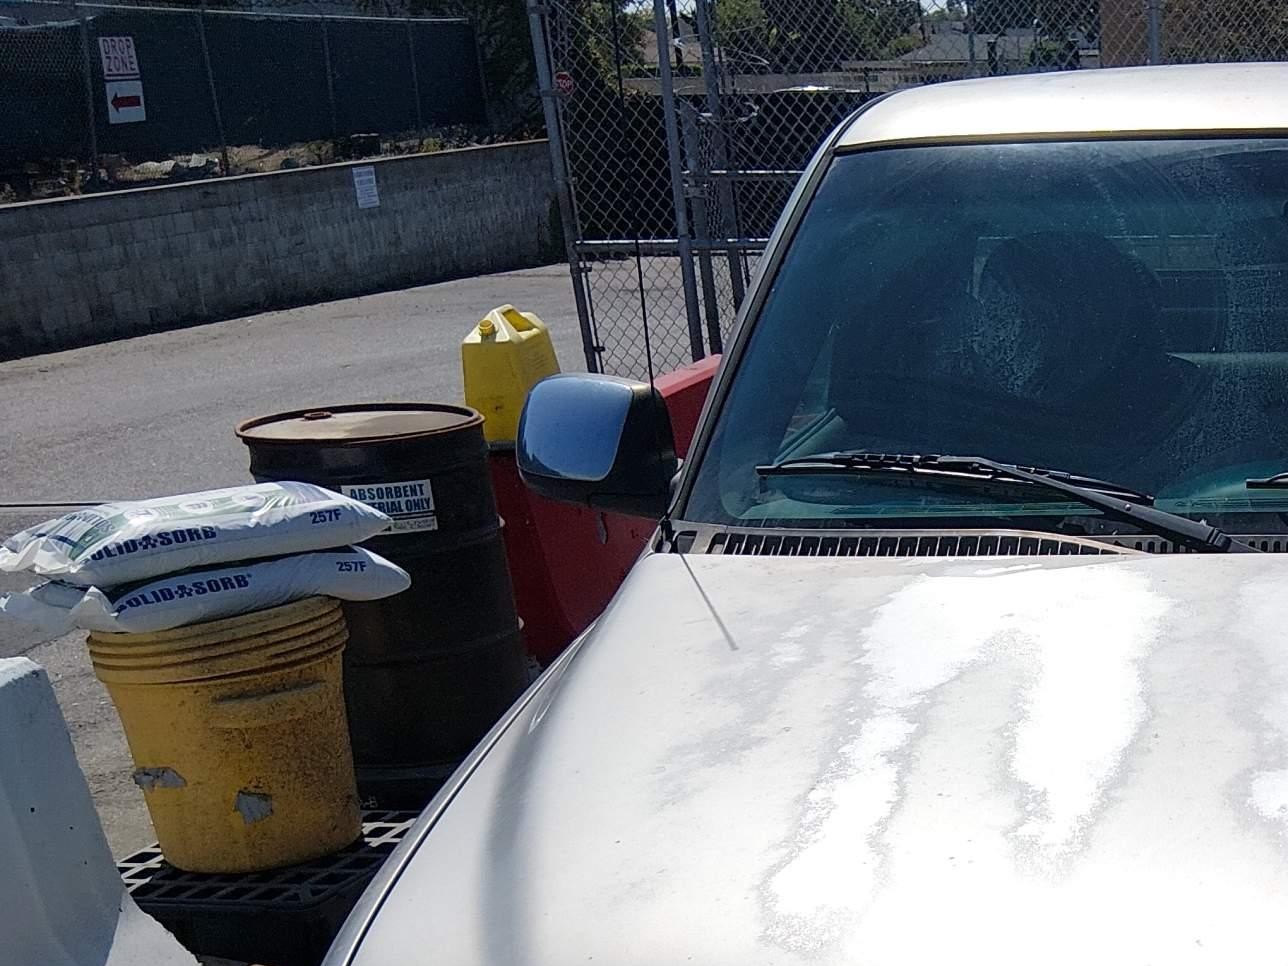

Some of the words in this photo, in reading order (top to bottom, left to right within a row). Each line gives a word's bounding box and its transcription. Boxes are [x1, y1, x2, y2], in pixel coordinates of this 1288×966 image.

[102, 38, 132, 55] DROP
[105, 55, 137, 72] ZONE
[350, 483, 425, 501] ABSORBENT
[405, 497, 432, 512] ONLY
[310, 508, 342, 525] 257F
[336, 561, 367, 573] 257F
